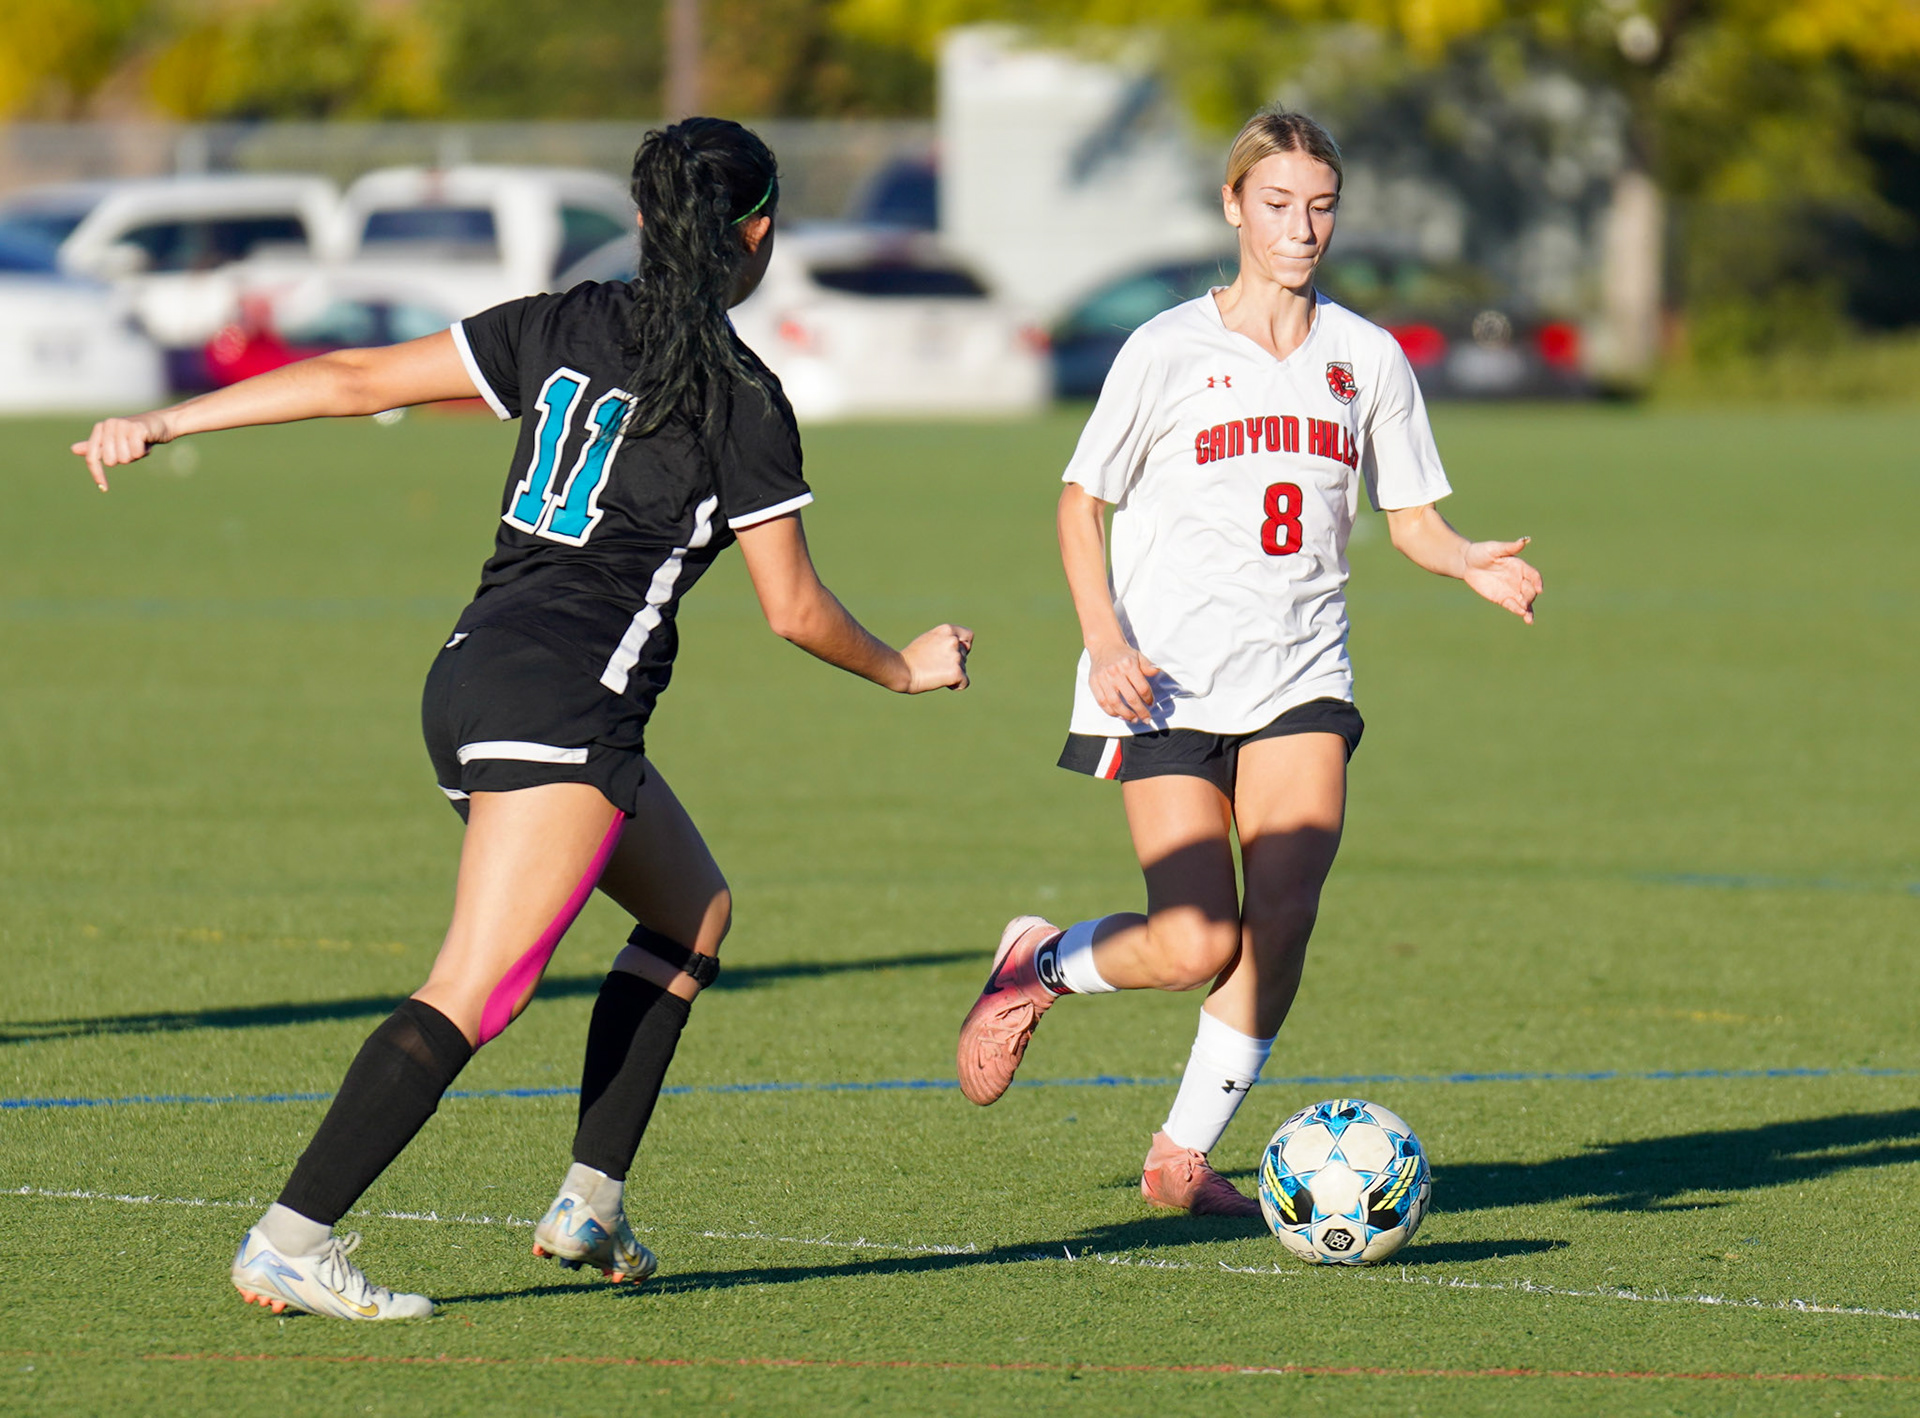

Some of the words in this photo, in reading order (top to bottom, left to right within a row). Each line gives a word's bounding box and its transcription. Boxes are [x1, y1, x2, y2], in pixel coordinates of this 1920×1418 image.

[502, 366, 639, 548] 11
[1195, 415, 1300, 465] CANYON
[1261, 482, 1303, 556] 8
